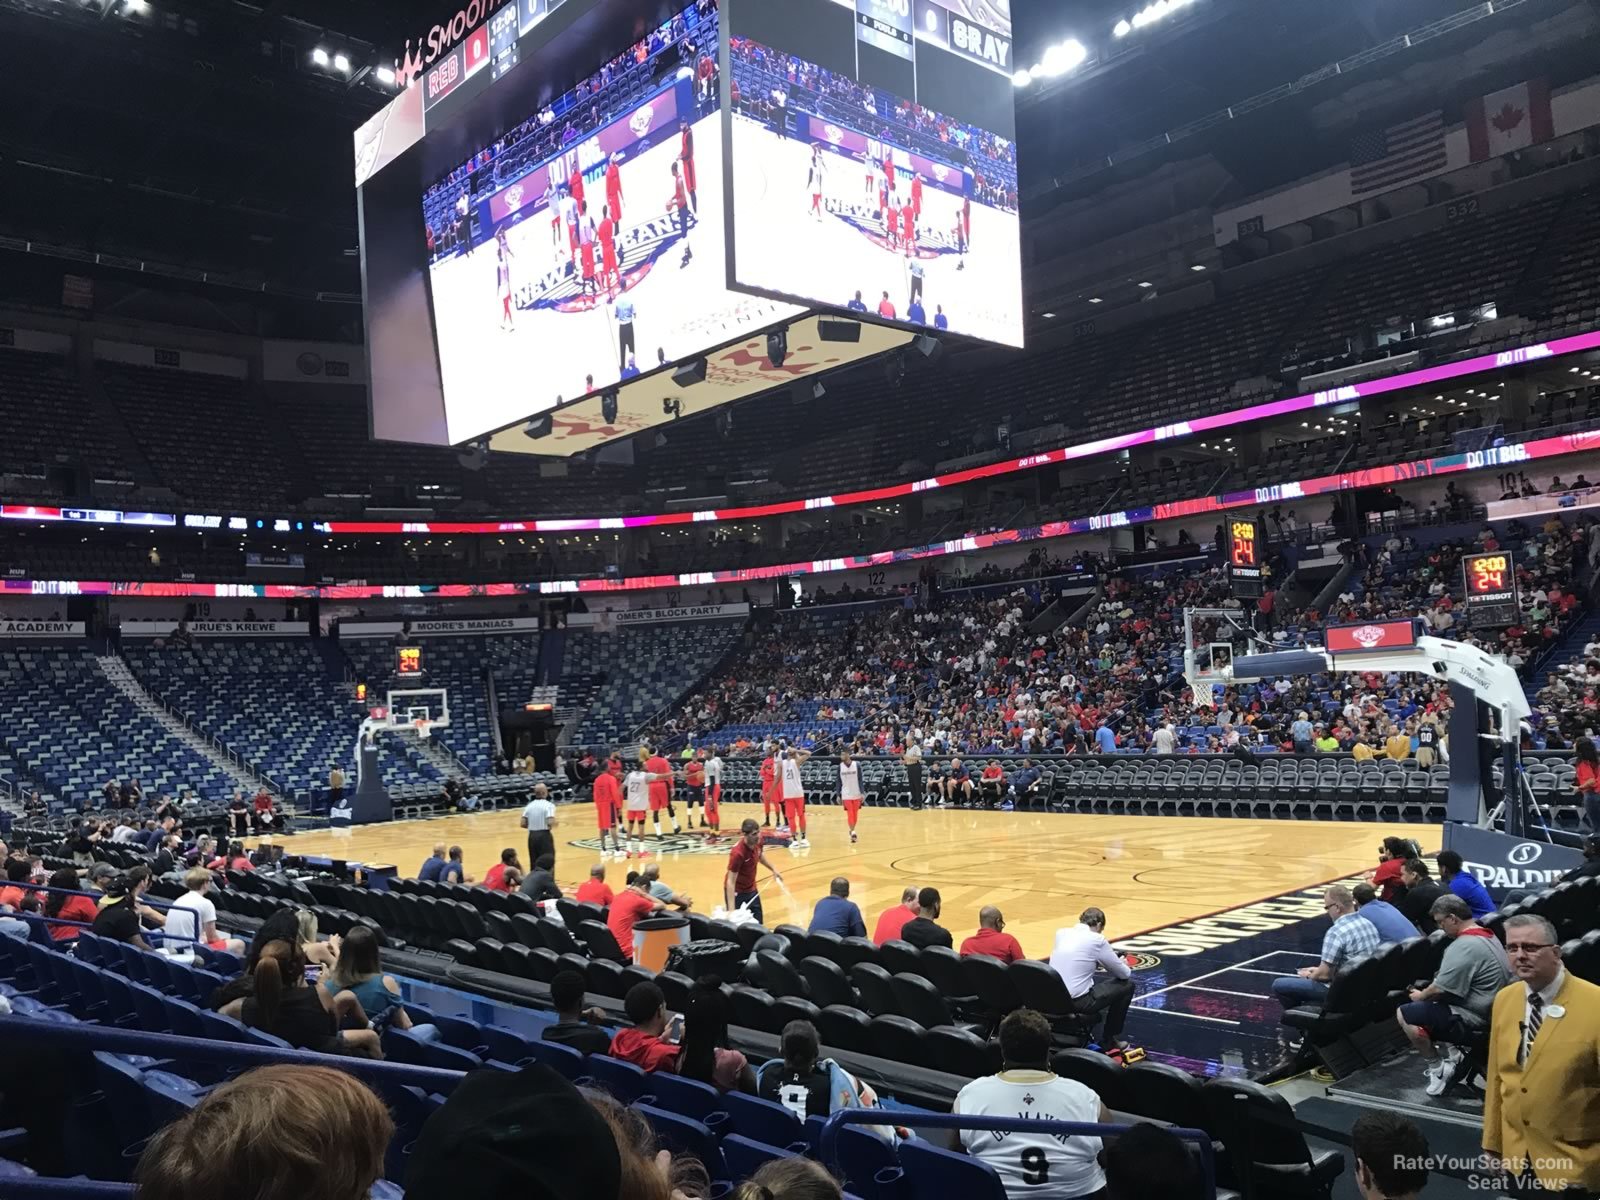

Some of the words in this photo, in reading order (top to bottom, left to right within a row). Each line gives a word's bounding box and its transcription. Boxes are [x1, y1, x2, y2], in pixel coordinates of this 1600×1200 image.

[491, 5, 516, 36] 12:00
[925, 9, 937, 32] 0
[473, 38, 481, 60] 0
[1448, 200, 1478, 218] 332
[1074, 322, 1094, 337] 330
[1496, 351, 1511, 366] DO
[1514, 348, 1526, 362] IT
[1466, 451, 1484, 468] DO
[1486, 448, 1497, 465] IT
[1498, 471, 1525, 491] 101
[1255, 488, 1269, 502] DO
[1270, 485, 1280, 500] IT
[1089, 516, 1101, 530] DO
[1102, 514, 1110, 528] IT
[945, 541, 954, 553] DO
[955, 539, 961, 551] IT
[1234, 539, 1254, 564] 24
[868, 572, 885, 586] 122
[1478, 572, 1502, 589] 24
[32, 581, 46, 594] DO
[48, 581, 57, 594] IT
[1480, 592, 1512, 601] TISSOT
[616, 610, 652, 621] OMER'S
[655, 608, 687, 618] BLOCK
[690, 605, 722, 616] PARTY
[6, 623, 73, 632] ACADEMY
[192, 623, 233, 632] JRUE'S
[236, 623, 276, 631] KREWE
[417, 621, 465, 630] MOORE'S
[467, 620, 514, 629] MANIACS
[400, 658, 418, 671] 24
[1459, 666, 1491, 690] SPALDING
[1420, 732, 1432, 742] 00
[629, 781, 641, 793] 27
[1021, 1146, 1049, 1185] 9
